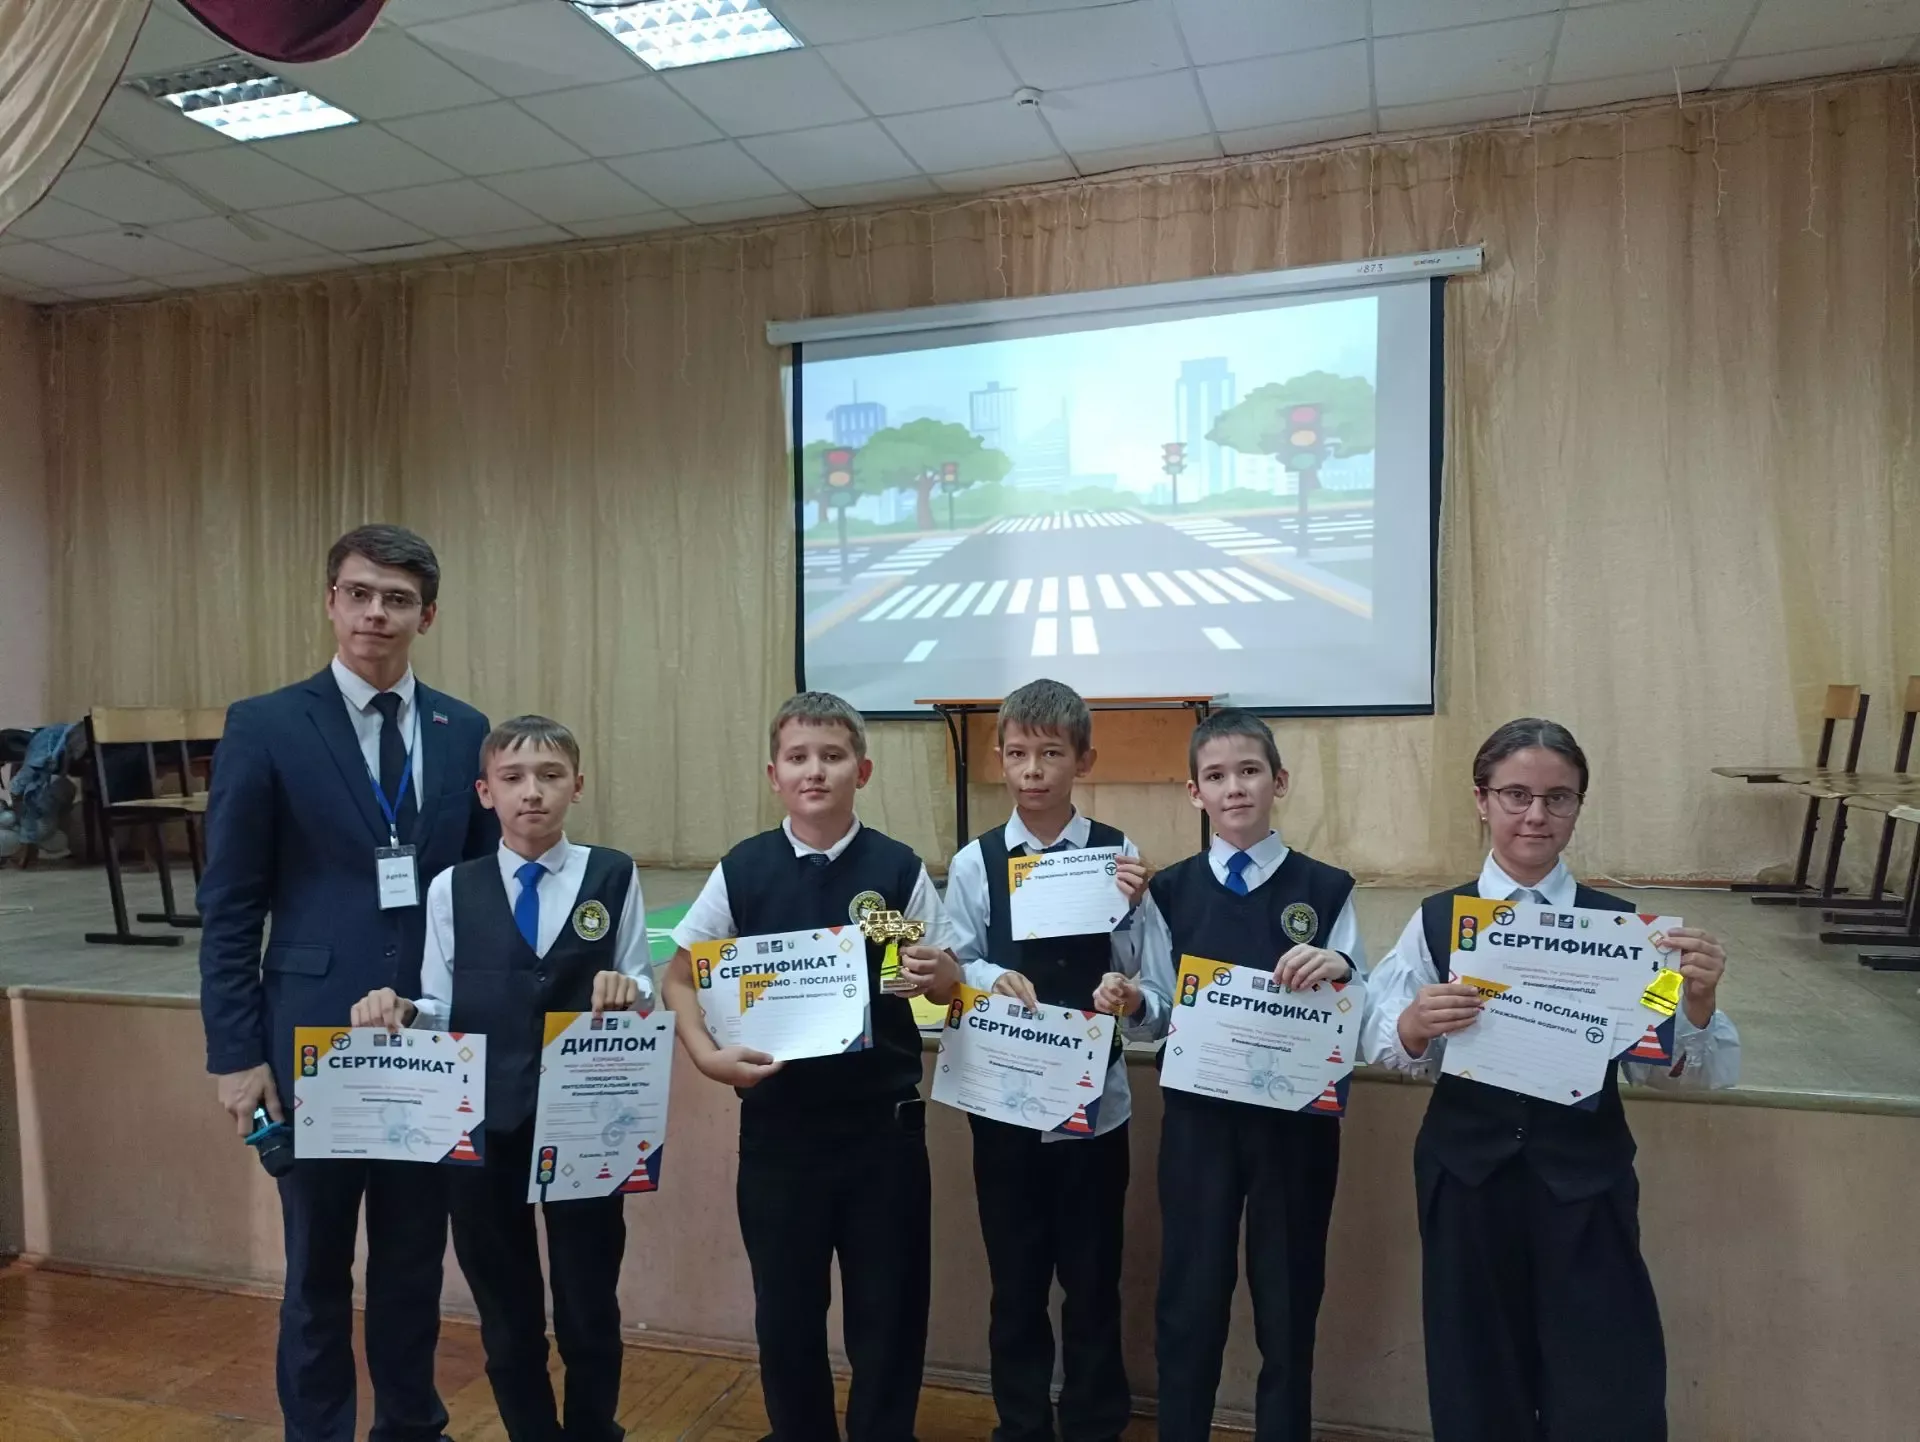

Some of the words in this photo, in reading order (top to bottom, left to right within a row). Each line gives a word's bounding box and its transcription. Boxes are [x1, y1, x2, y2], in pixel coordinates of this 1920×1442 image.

[1014, 858, 1055, 870] ПИСЬМО
[1488, 931, 1644, 961] СЕРТИФИКАТ
[720, 955, 838, 980] СЕРТИФИКАТ
[745, 978, 791, 989] ПИСЬМО
[799, 974, 857, 986] ПОСЛАНИЕ
[1206, 990, 1333, 1024] СЕРТИФИКАТ
[1471, 985, 1523, 1005] ИСЬМО
[1533, 1000, 1609, 1027] ПОСЛАНИЕ
[968, 1015, 1083, 1050] СЕРТИФИКАТ
[561, 1037, 657, 1056] ДИПЛОМ
[328, 1055, 456, 1074] СЕРТИФИКАТ
